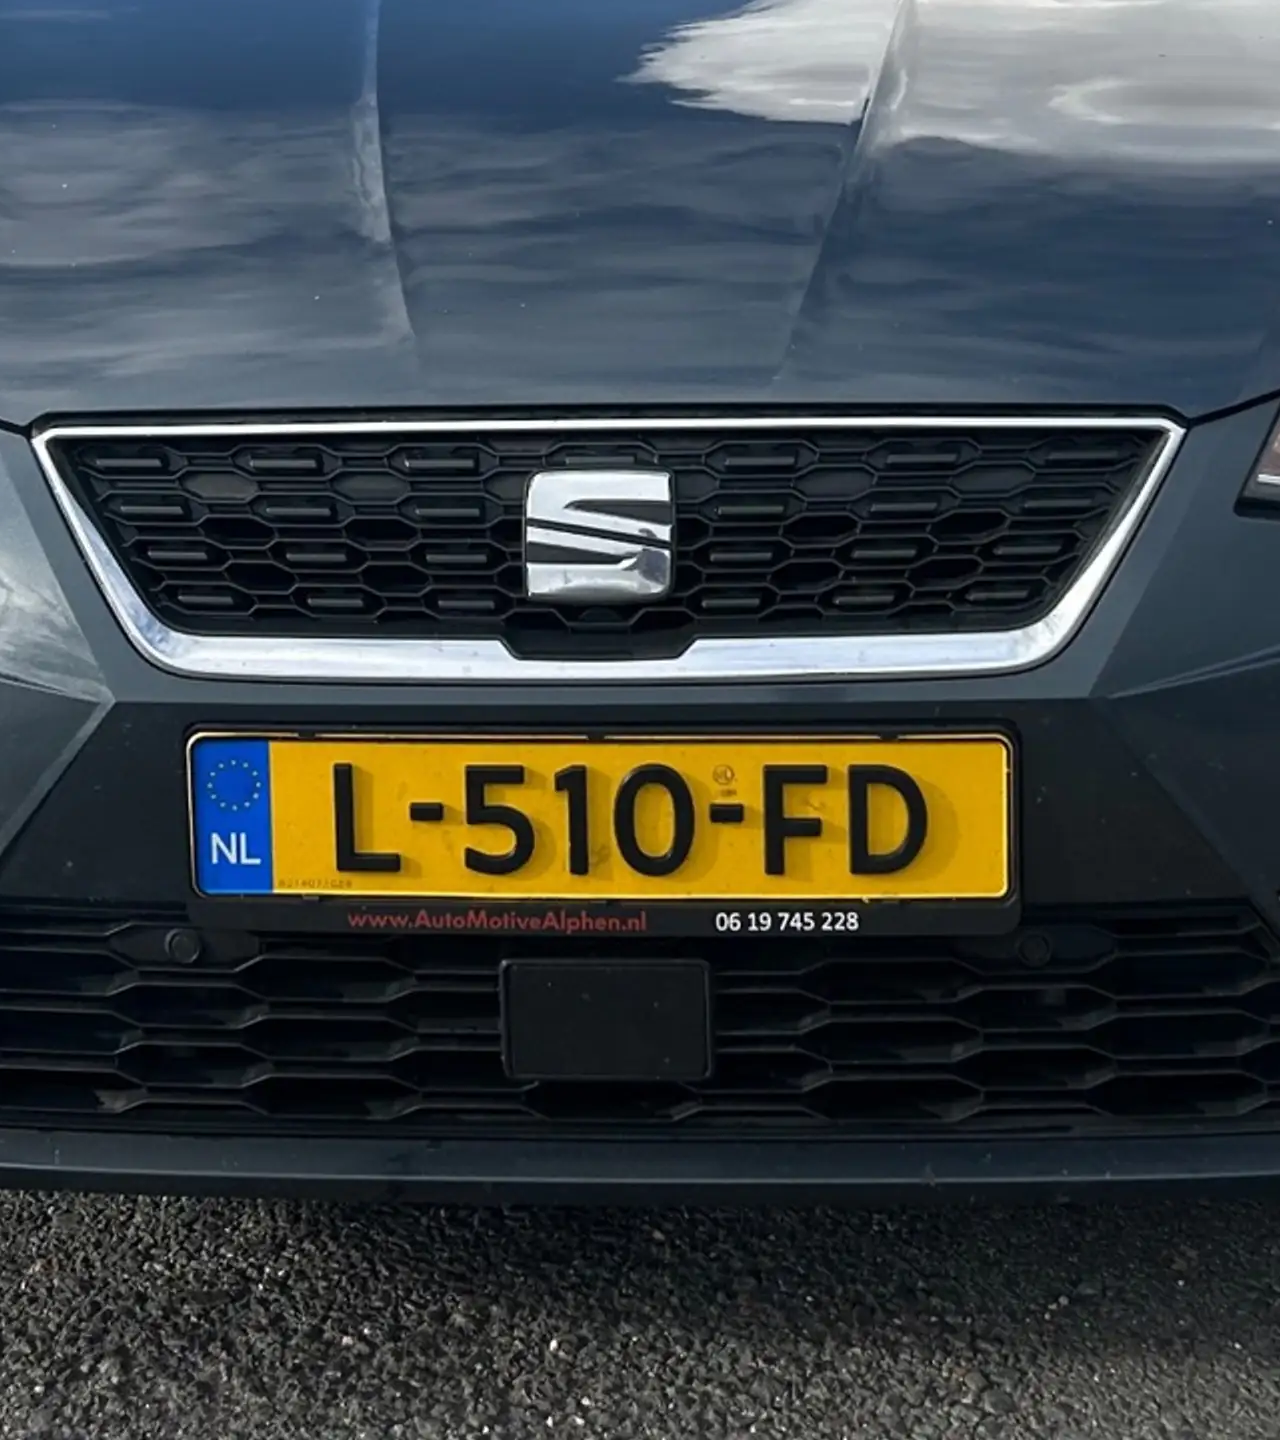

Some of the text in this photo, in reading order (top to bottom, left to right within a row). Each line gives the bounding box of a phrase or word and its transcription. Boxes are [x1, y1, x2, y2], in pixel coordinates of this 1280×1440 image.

[332, 762, 927, 877] L-510-FD
[211, 832, 262, 865] NL
[347, 908, 647, 935] www.AutoMotiveAlphen.nl
[715, 911, 860, 931] 06 19 745 228
